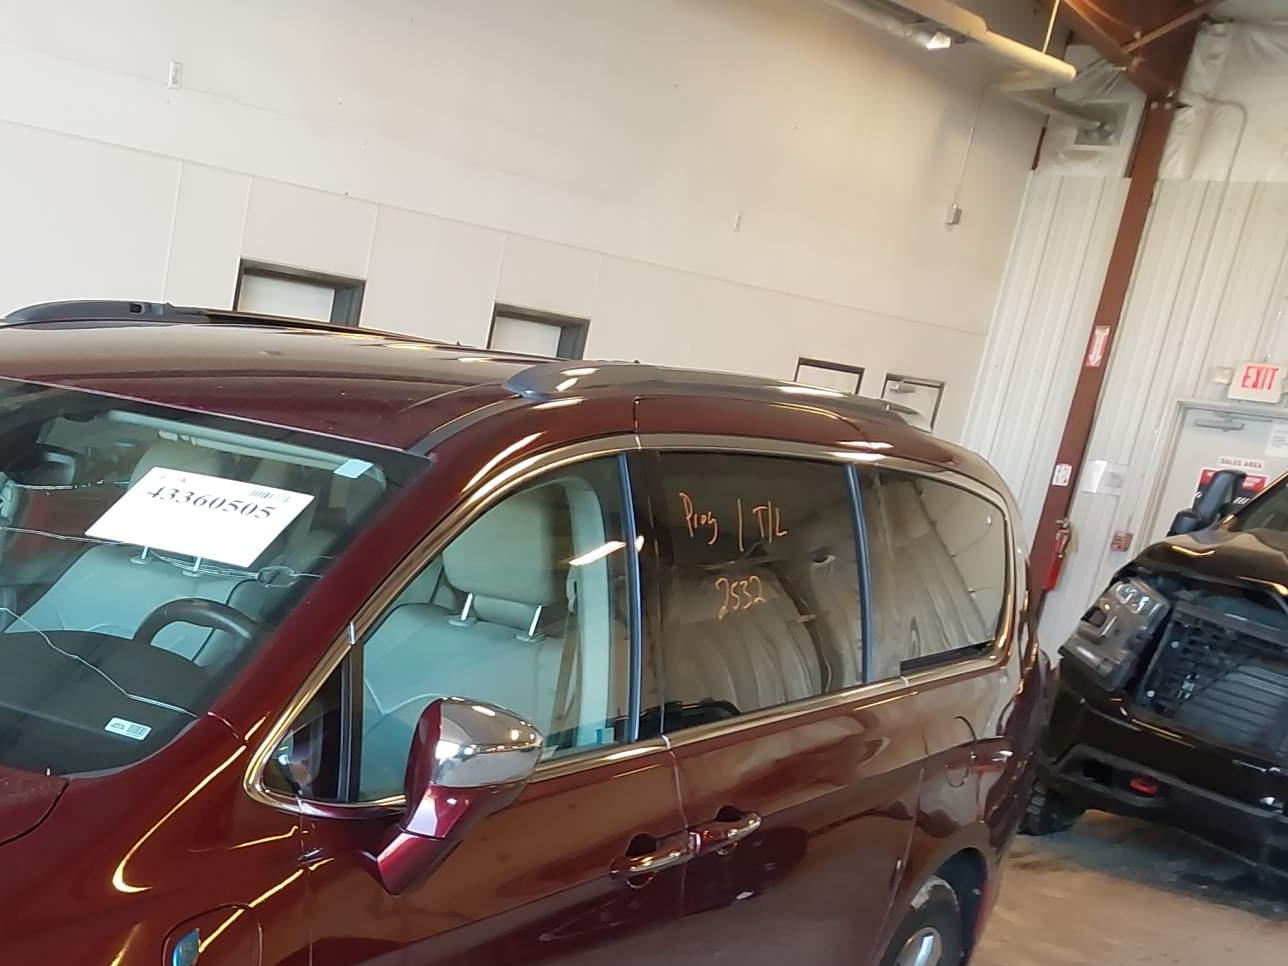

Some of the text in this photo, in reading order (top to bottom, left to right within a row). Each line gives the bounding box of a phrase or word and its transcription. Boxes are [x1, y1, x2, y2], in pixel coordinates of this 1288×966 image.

[1241, 365, 1279, 390] EXIT
[1220, 457, 1263, 469] SALES AREA
[146, 486, 276, 519] 43360505
[715, 575, 766, 620] 2532
